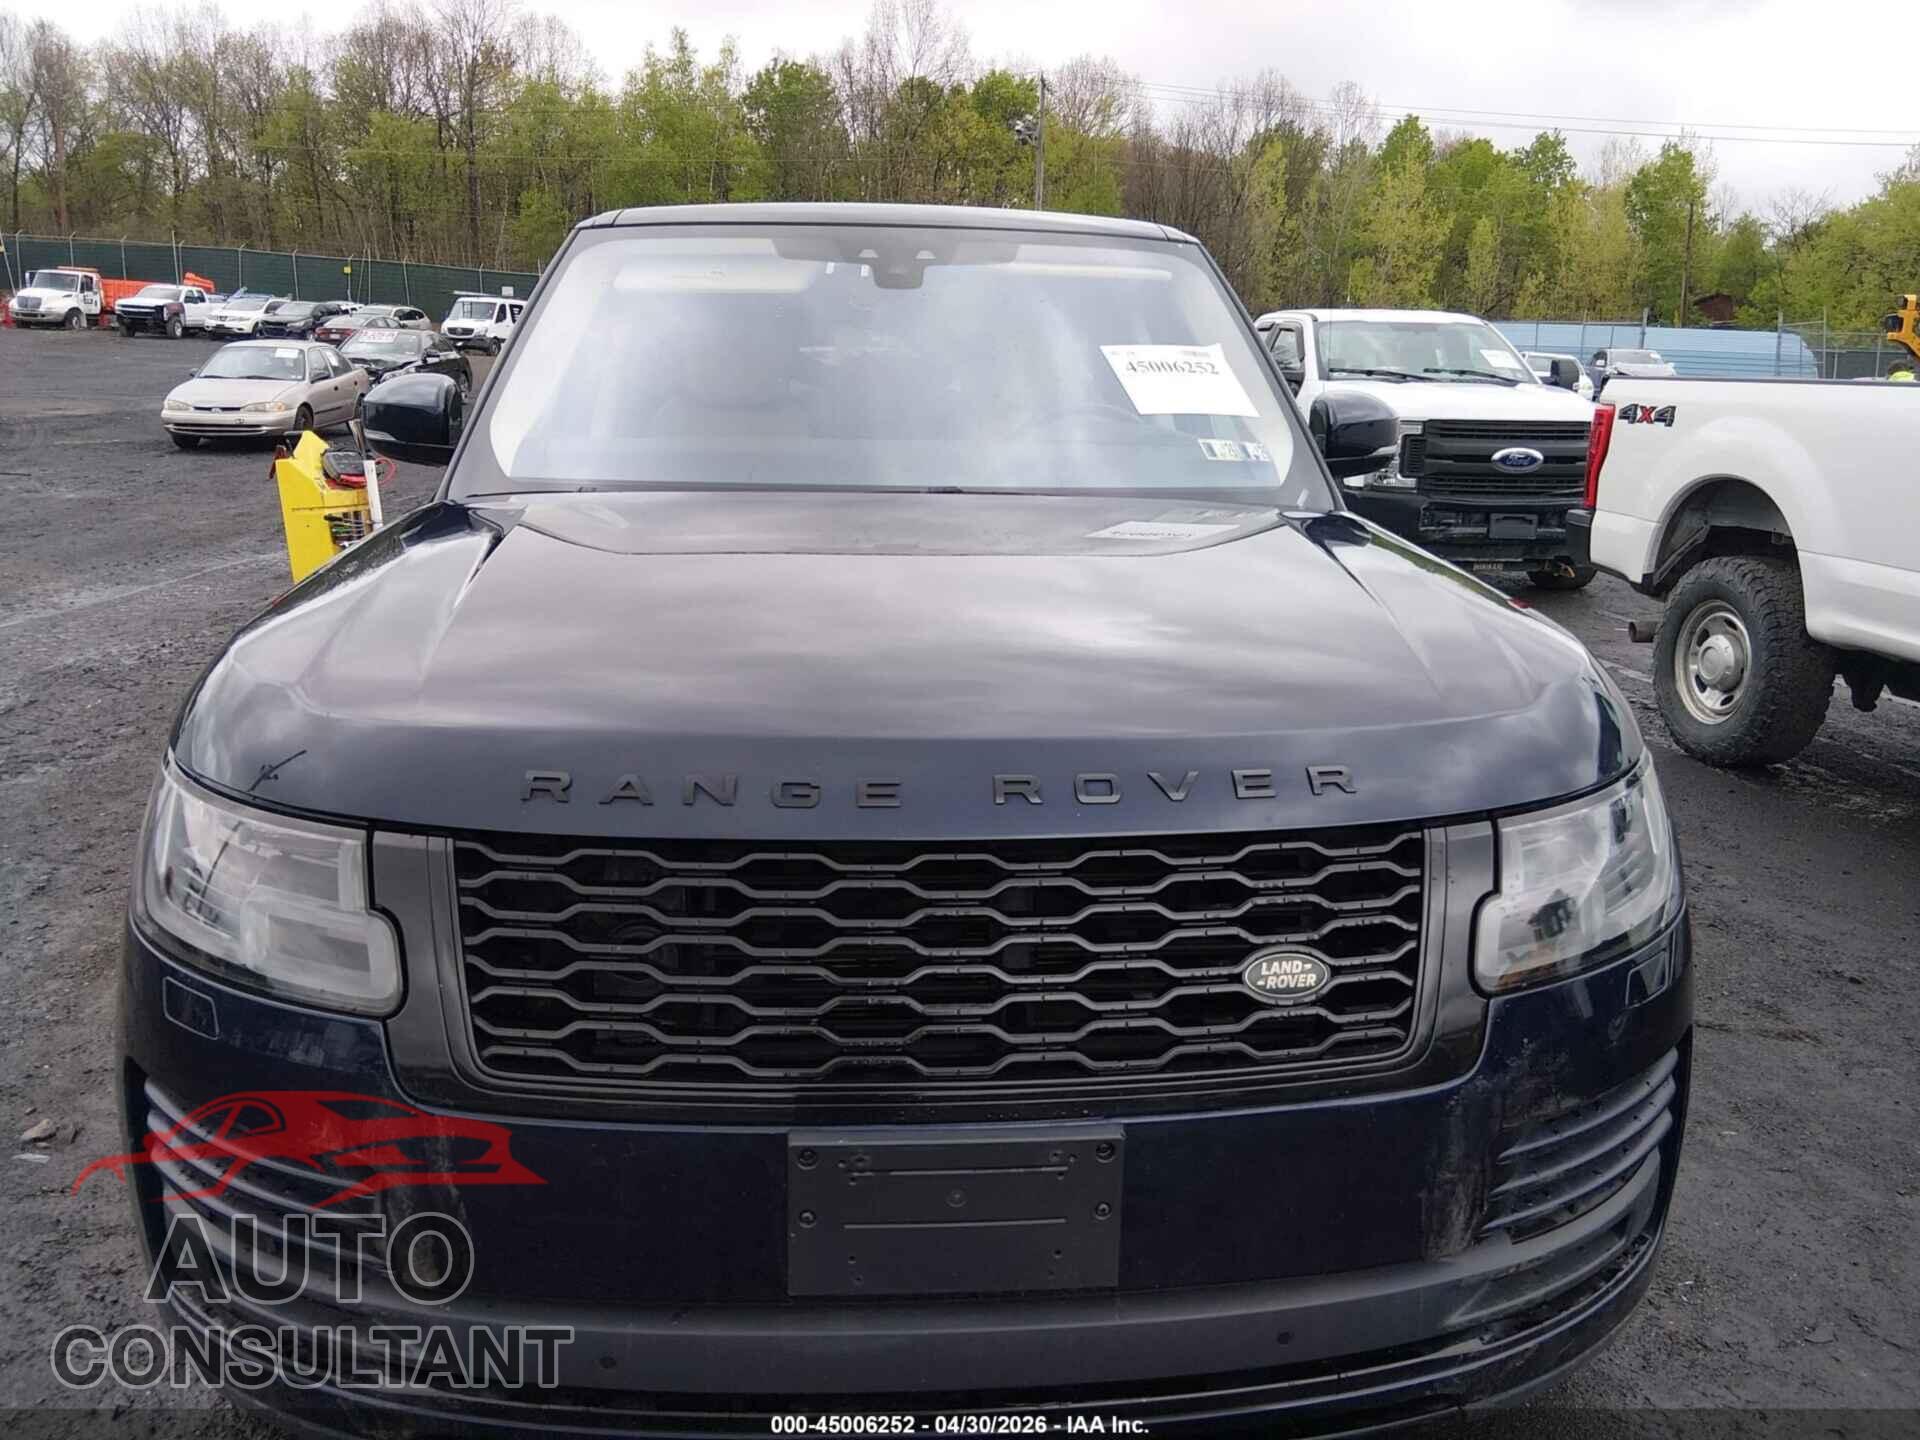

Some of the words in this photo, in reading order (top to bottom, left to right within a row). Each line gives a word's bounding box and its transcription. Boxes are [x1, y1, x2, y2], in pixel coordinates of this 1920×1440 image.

[1126, 359, 1220, 376] 45006252
[1505, 453, 1532, 466] Ford
[521, 770, 902, 808] RANGE
[992, 765, 1358, 805] ROVER
